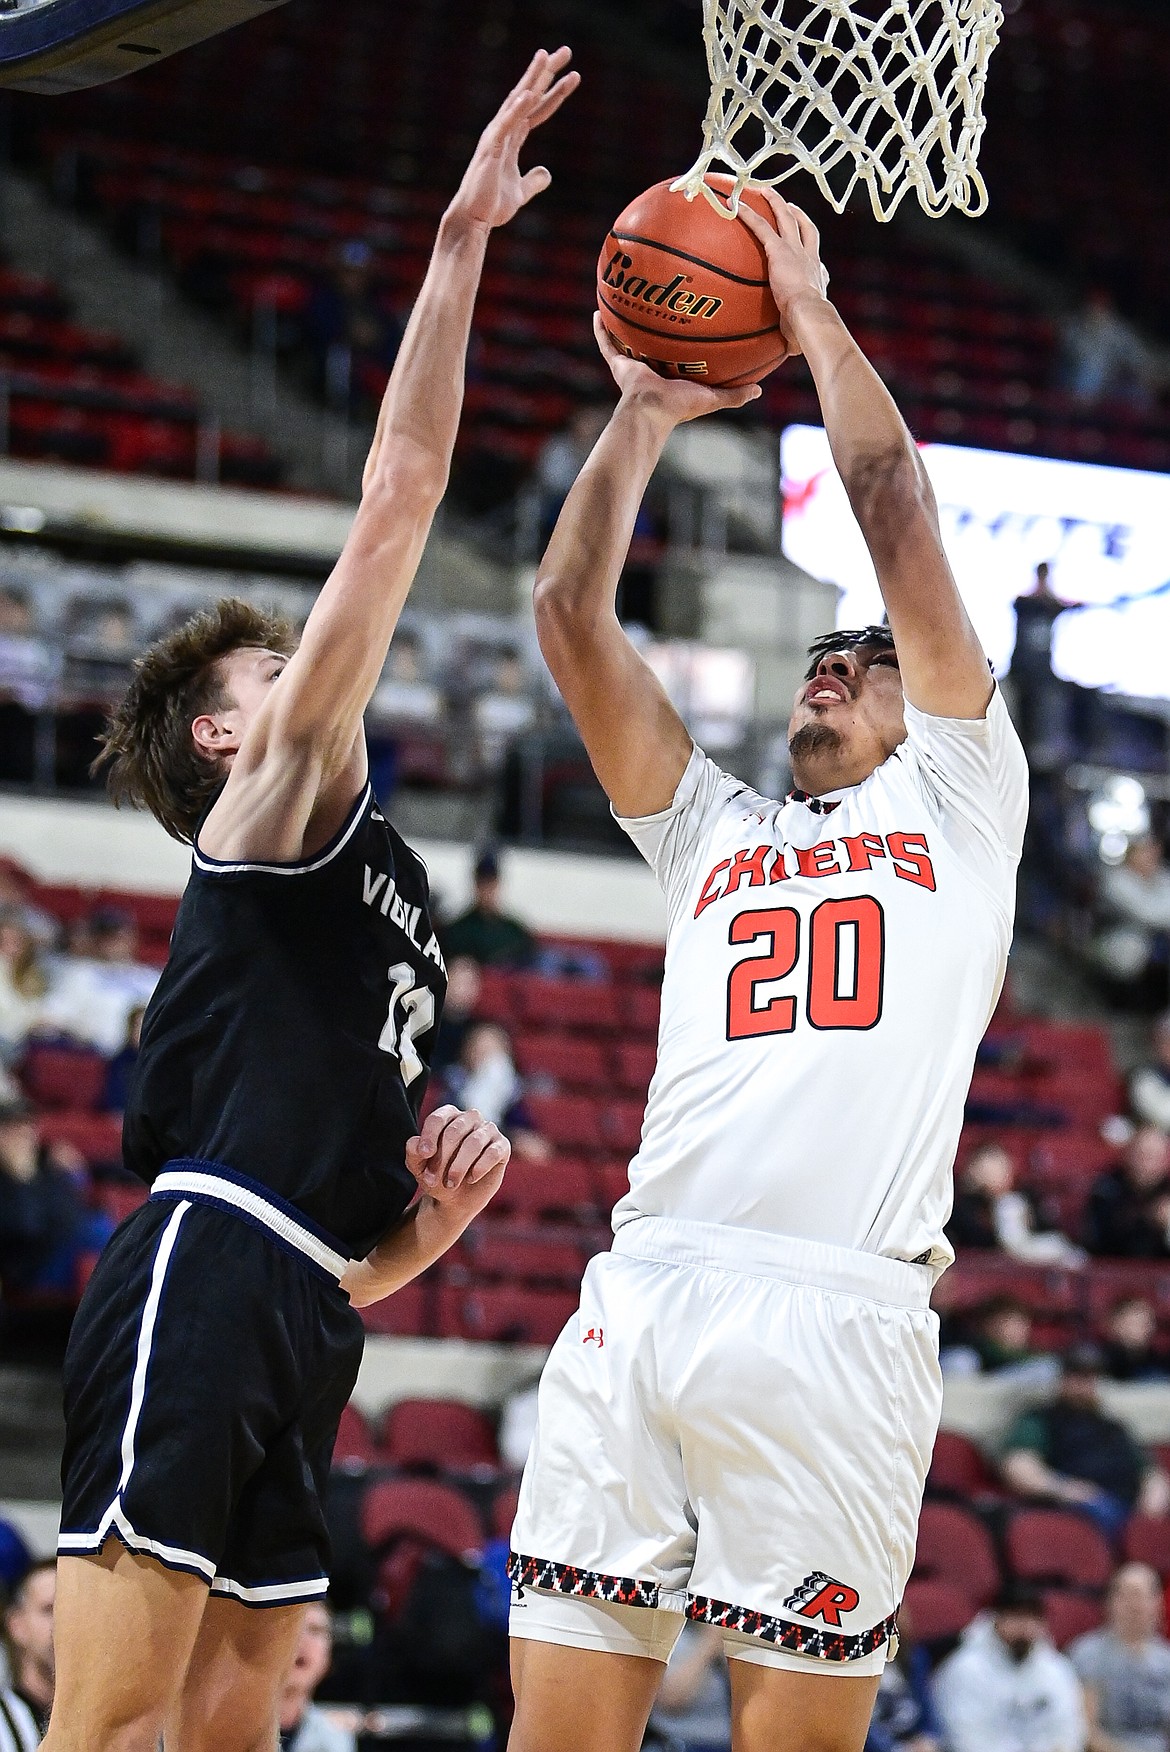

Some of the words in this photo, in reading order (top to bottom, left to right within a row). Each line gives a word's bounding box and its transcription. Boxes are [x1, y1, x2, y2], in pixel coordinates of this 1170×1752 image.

[602, 251, 724, 319] Baden
[611, 293, 688, 325] PERFECTION
[694, 831, 937, 920] CHIEFS
[726, 894, 885, 1042] 20
